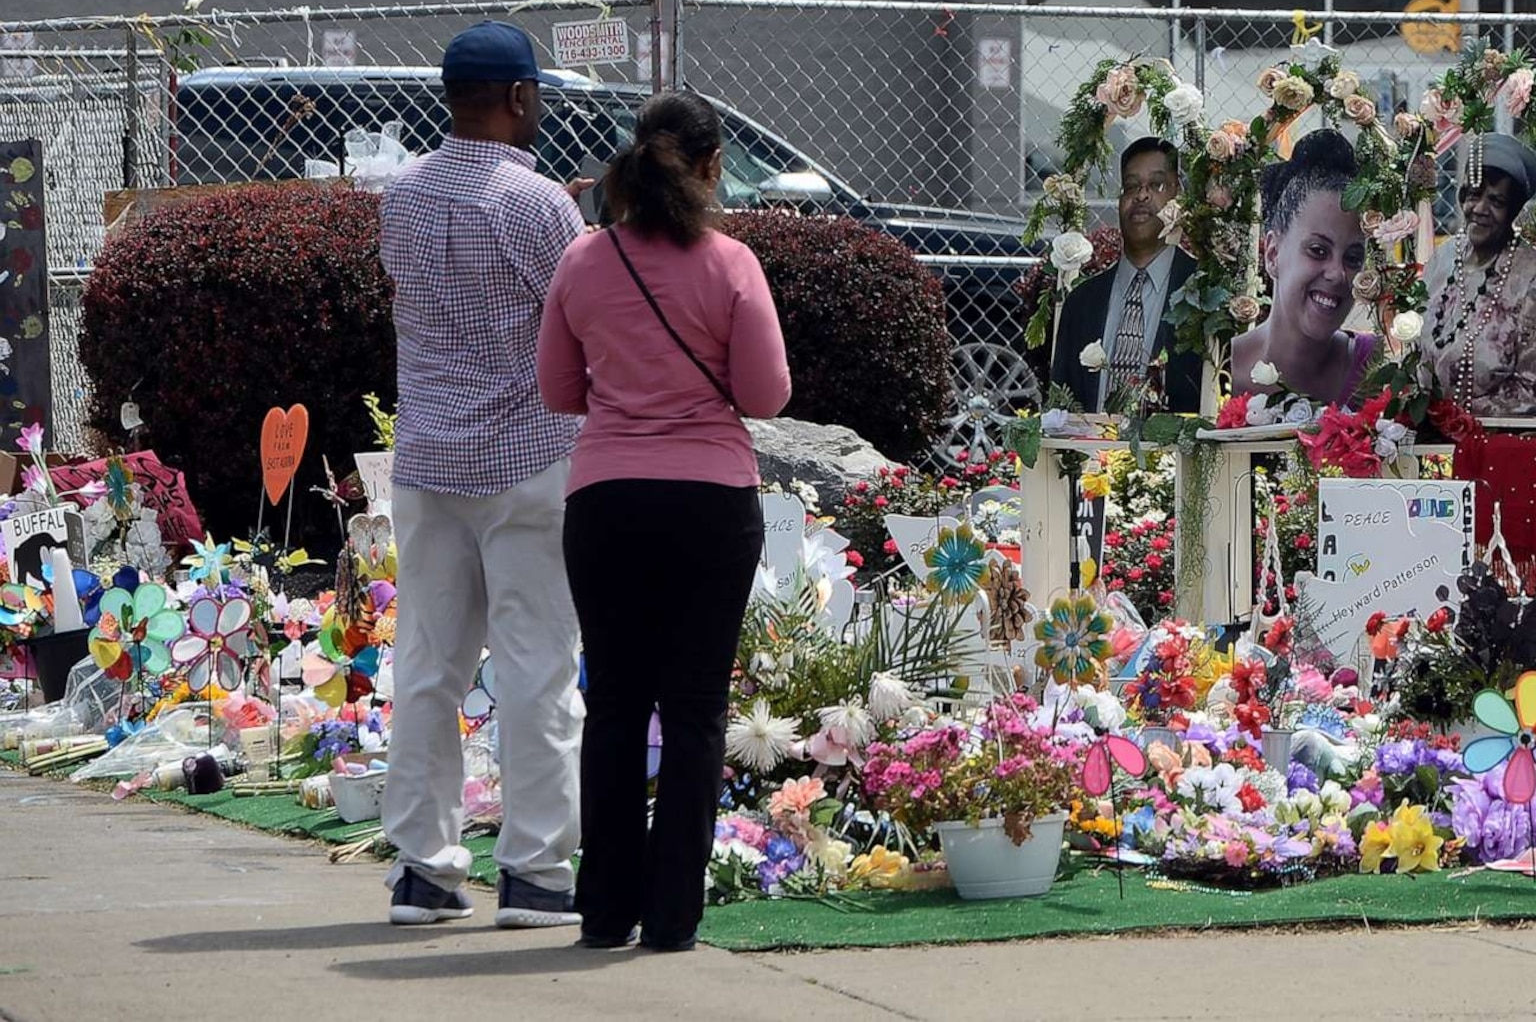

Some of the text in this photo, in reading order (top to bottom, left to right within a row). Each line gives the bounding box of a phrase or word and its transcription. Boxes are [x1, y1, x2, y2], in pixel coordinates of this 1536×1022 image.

[556, 21, 623, 41] WOODSMITH
[558, 36, 623, 49] FENCE RENTAL
[274, 422, 294, 439] LOVE
[13, 509, 66, 536] BUFFAL
[763, 519, 795, 532] EACE
[1344, 511, 1391, 527] PEACE
[1332, 553, 1439, 624] Heyward Patterson
